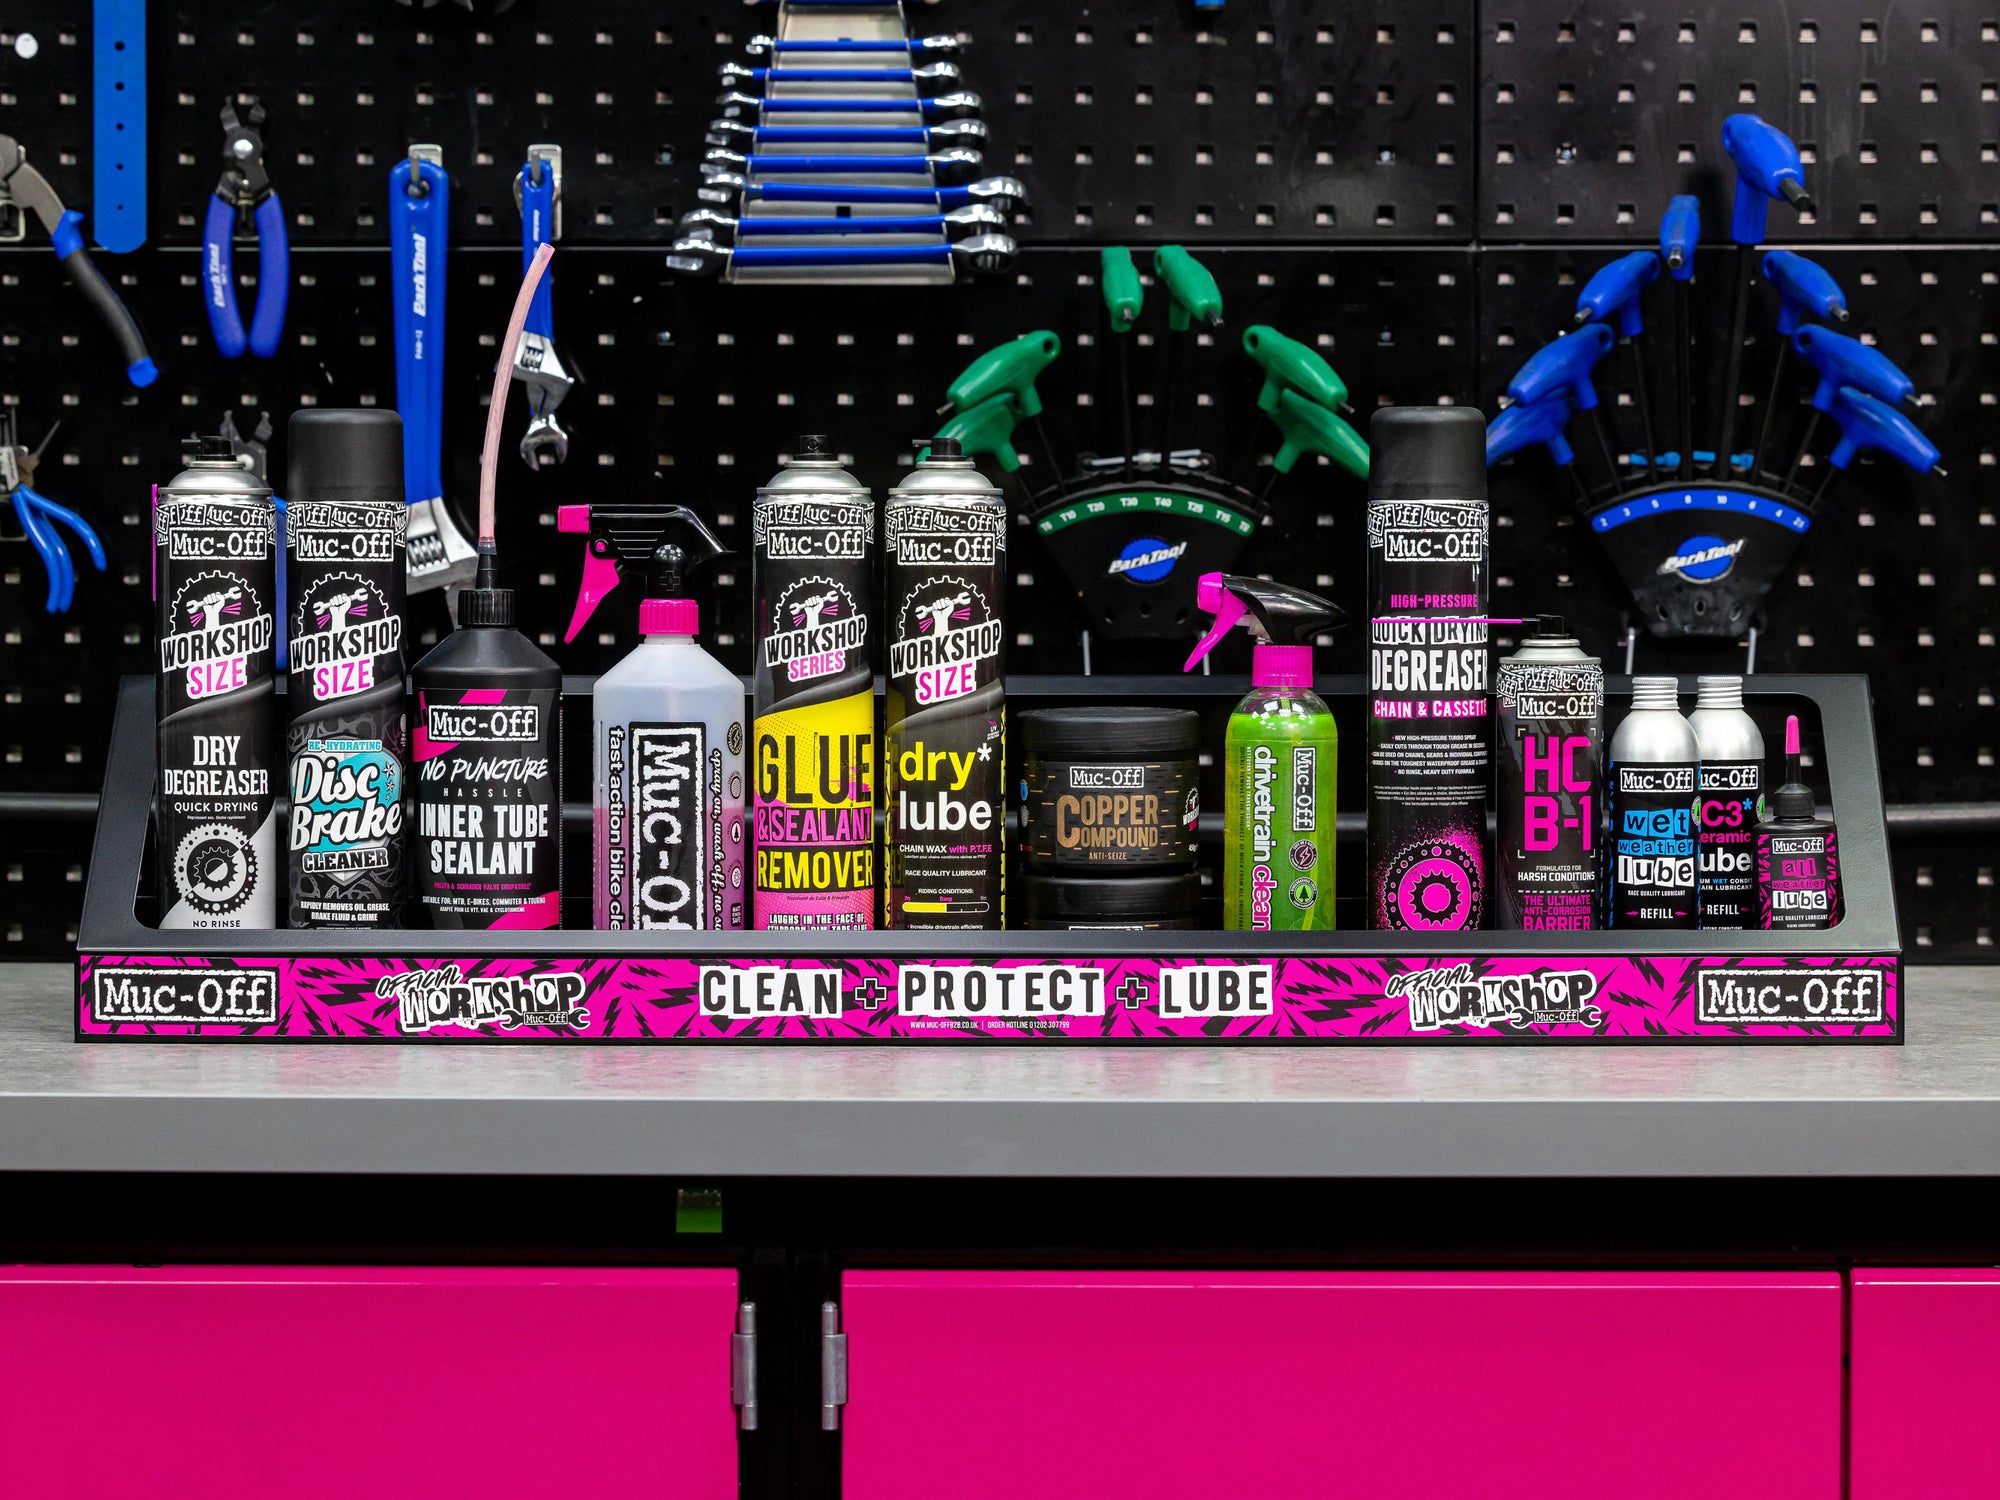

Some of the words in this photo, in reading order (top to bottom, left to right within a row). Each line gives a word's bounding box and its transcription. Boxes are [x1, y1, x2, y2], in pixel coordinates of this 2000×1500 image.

[1060, 510, 1077, 522] T10
[1086, 502, 1105, 513] T20
[1154, 496, 1173, 508] T40
[1216, 510, 1232, 523] T15
[1623, 508, 1631, 517] 3
[1717, 494, 1728, 505] 10
[173, 532, 264, 555] Muc-Off
[299, 533, 391, 557] Muc-Off
[771, 530, 861, 555] Muc-Off
[901, 537, 992, 561] Muc-Off
[1389, 533, 1479, 557] Muc-Off
[1391, 594, 1478, 608] HIGH-PRESSURE
[162, 616, 271, 671] WORKSHOP
[766, 617, 865, 666] WORKSHOP
[1374, 619, 1423, 643] QUICK
[291, 619, 399, 672] WORKSHOP
[892, 622, 1000, 676] WORKSHOP
[190, 657, 244, 696] SIZE
[317, 659, 371, 697] SIZE
[790, 651, 844, 680] SERIES
[1372, 649, 1488, 691] DEGREASER
[919, 663, 973, 701] SIZE
[1374, 700, 1412, 718] CHAIN
[1418, 702, 1427, 716] &
[1432, 699, 1486, 717] CASSETTE
[1521, 696, 1594, 716] Muc-Off
[433, 710, 535, 737] Muc-Off
[193, 736, 241, 766] DRY
[610, 728, 624, 773] fast
[421, 758, 447, 781] NO
[451, 756, 548, 784] PUNCTURE
[710, 750, 722, 794] spray
[759, 734, 871, 804] GLUE
[1074, 770, 1141, 785] Muc-Off
[1524, 736, 1592, 793] HC
[164, 769, 268, 796] DEGREASER
[294, 755, 379, 804] Disc
[1296, 752, 1312, 829] Muc-Off
[1623, 772, 1691, 790] Muc-Off
[1701, 770, 1756, 787] uc-Off
[174, 802, 211, 814] QUICK
[214, 802, 258, 812] DRYING
[610, 776, 624, 843] action
[712, 795, 721, 819] on,
[900, 791, 992, 831] lube
[1254, 746, 1277, 862] drivetrain
[291, 799, 402, 850] Brake
[420, 803, 484, 838] INNER
[494, 804, 549, 838] TUBE
[1056, 795, 1158, 845] COPPER
[1524, 796, 1592, 851] B-1
[1625, 811, 1689, 835] wet
[714, 822, 725, 864] wash
[900, 844, 923, 852] CHAIN
[926, 845, 947, 853] WAX
[949, 845, 968, 853] with
[1619, 840, 1693, 855] weather
[1700, 831, 1751, 844] eramic
[1774, 840, 1822, 852] Muc-Off
[303, 849, 388, 872] CLEANER
[431, 840, 536, 875] SEALANT
[1088, 852, 1127, 860] ANTI-SEIZE
[1700, 848, 1751, 872] ube
[1784, 860, 1815, 878] all
[610, 850, 624, 898] bike
[758, 851, 873, 888] REMOVER
[1518, 872, 1546, 881] HARSH
[1549, 872, 1595, 881] CONDITIONS
[1622, 858, 1693, 884] lube
[1252, 865, 1277, 930] clean
[1773, 880, 1825, 889] weather
[300, 900, 322, 910] RAPIDLY
[323, 902, 353, 911] REMOVES
[367, 903, 390, 911] GREASE,
[1524, 896, 1544, 905] THE
[1548, 895, 1591, 905] ULTIMATE
[1524, 906, 1591, 915] ANTI-CORROSION
[1707, 905, 1739, 915] REFILL
[1777, 892, 1825, 908] lube
[193, 920, 207, 928] NO
[212, 920, 241, 928] RINSE
[311, 912, 331, 920] BRAKE
[770, 914, 799, 924] LAUGHS
[804, 915, 812, 925] IN
[816, 915, 832, 924] THE
[836, 914, 854, 924] FACE
[857, 914, 864, 923] OF
[1524, 916, 1591, 930] BARRIER
[1641, 908, 1673, 919] REFILL
[378, 967, 460, 997] OFFICIAL
[704, 970, 837, 1015] CLEAN
[904, 969, 1100, 1013] PROTECT
[1164, 971, 1267, 1013] LUBE
[1387, 966, 1472, 996] OFFICIAL
[103, 976, 267, 1017] Muc-Off
[404, 976, 582, 1028] WORKSHOP
[1414, 974, 1593, 1028] WORKSHOP
[1708, 976, 1875, 1016] Muc-Off
[526, 1013, 567, 1024] Muc-Off
[988, 1021, 1005, 1029] ORDER
[1006, 1021, 1028, 1029] HOTLINE
[1030, 1021, 1047, 1029] 01202
[1048, 1021, 1070, 1029] 307799
[1536, 1011, 1577, 1022] Muc-Off
